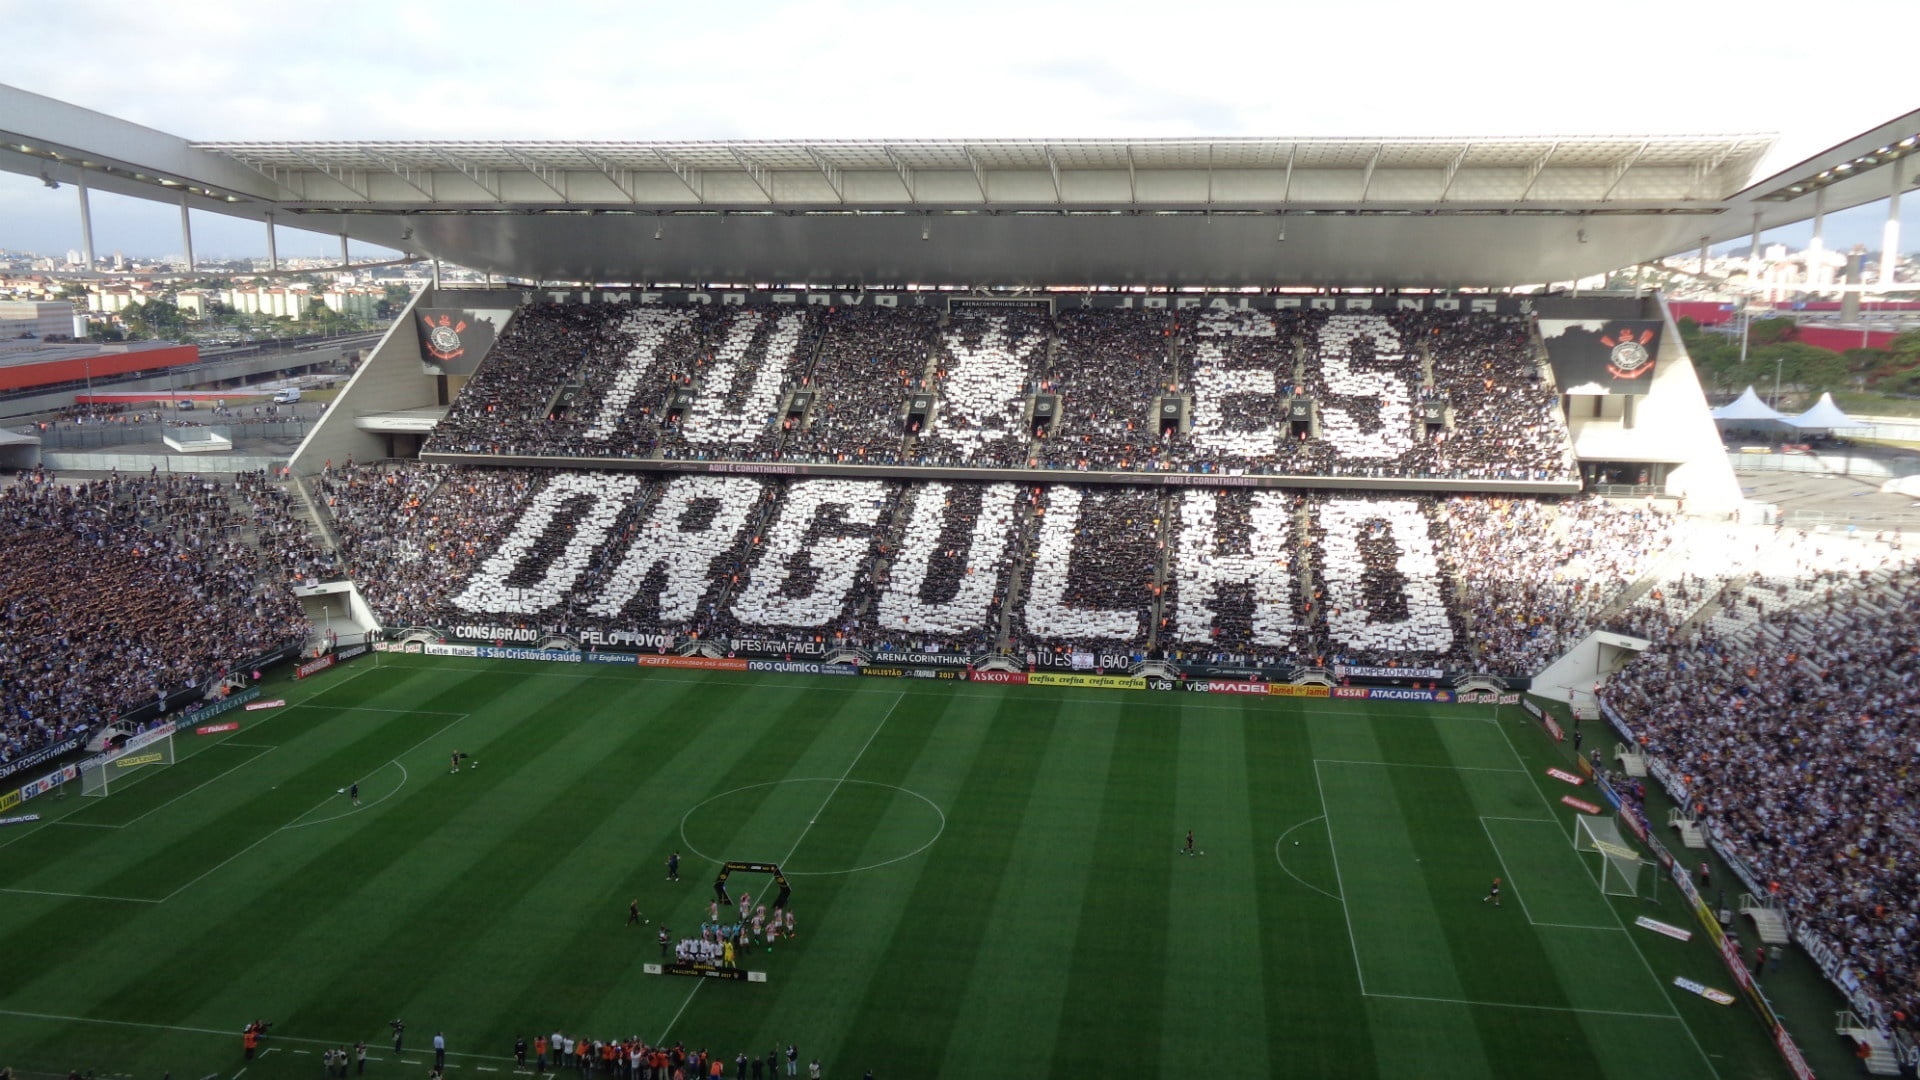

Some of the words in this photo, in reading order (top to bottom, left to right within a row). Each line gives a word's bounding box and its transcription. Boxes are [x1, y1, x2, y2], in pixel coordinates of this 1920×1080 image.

[547, 291, 662, 304] TIME
[583, 307, 804, 444] TU
[708, 463, 727, 472] AQUI
[728, 462, 735, 473] É
[735, 464, 796, 475] CORINTHIANS!!!
[1163, 475, 1184, 485] AQUI
[1185, 475, 1192, 485] É
[450, 471, 1454, 652] ORGULHO
[456, 625, 538, 642] CONSAGRADO
[580, 631, 618, 646] PELO
[427, 647, 449, 655] Leite
[452, 647, 476, 657] Italac
[788, 641, 826, 654] FAVELA
[488, 647, 504, 659] São
[505, 650, 552, 661] Cristóvão
[553, 651, 582, 663] saúde
[599, 654, 621, 663] English
[621, 655, 636, 663] Live
[876, 653, 907, 662] ARENA
[909, 654, 971, 665] CORINTHIANS
[1037, 651, 1053, 666] TU
[749, 661, 773, 671] neo
[863, 668, 902, 677] PAULISTÃO
[973, 672, 1010, 682] ASKOV
[1030, 675, 1055, 686] crefisa
[1059, 676, 1085, 686] crefisa
[1089, 677, 1114, 688] crefisa
[1118, 678, 1144, 688] crefisa
[1208, 682, 1268, 693] MADEL
[1270, 685, 1294, 696] Jamel
[1306, 686, 1330, 698] Jamel
[1370, 690, 1433, 701] ATACADISTA
[50, 770, 65, 786] Sil
[24, 783, 39, 800] Sil
